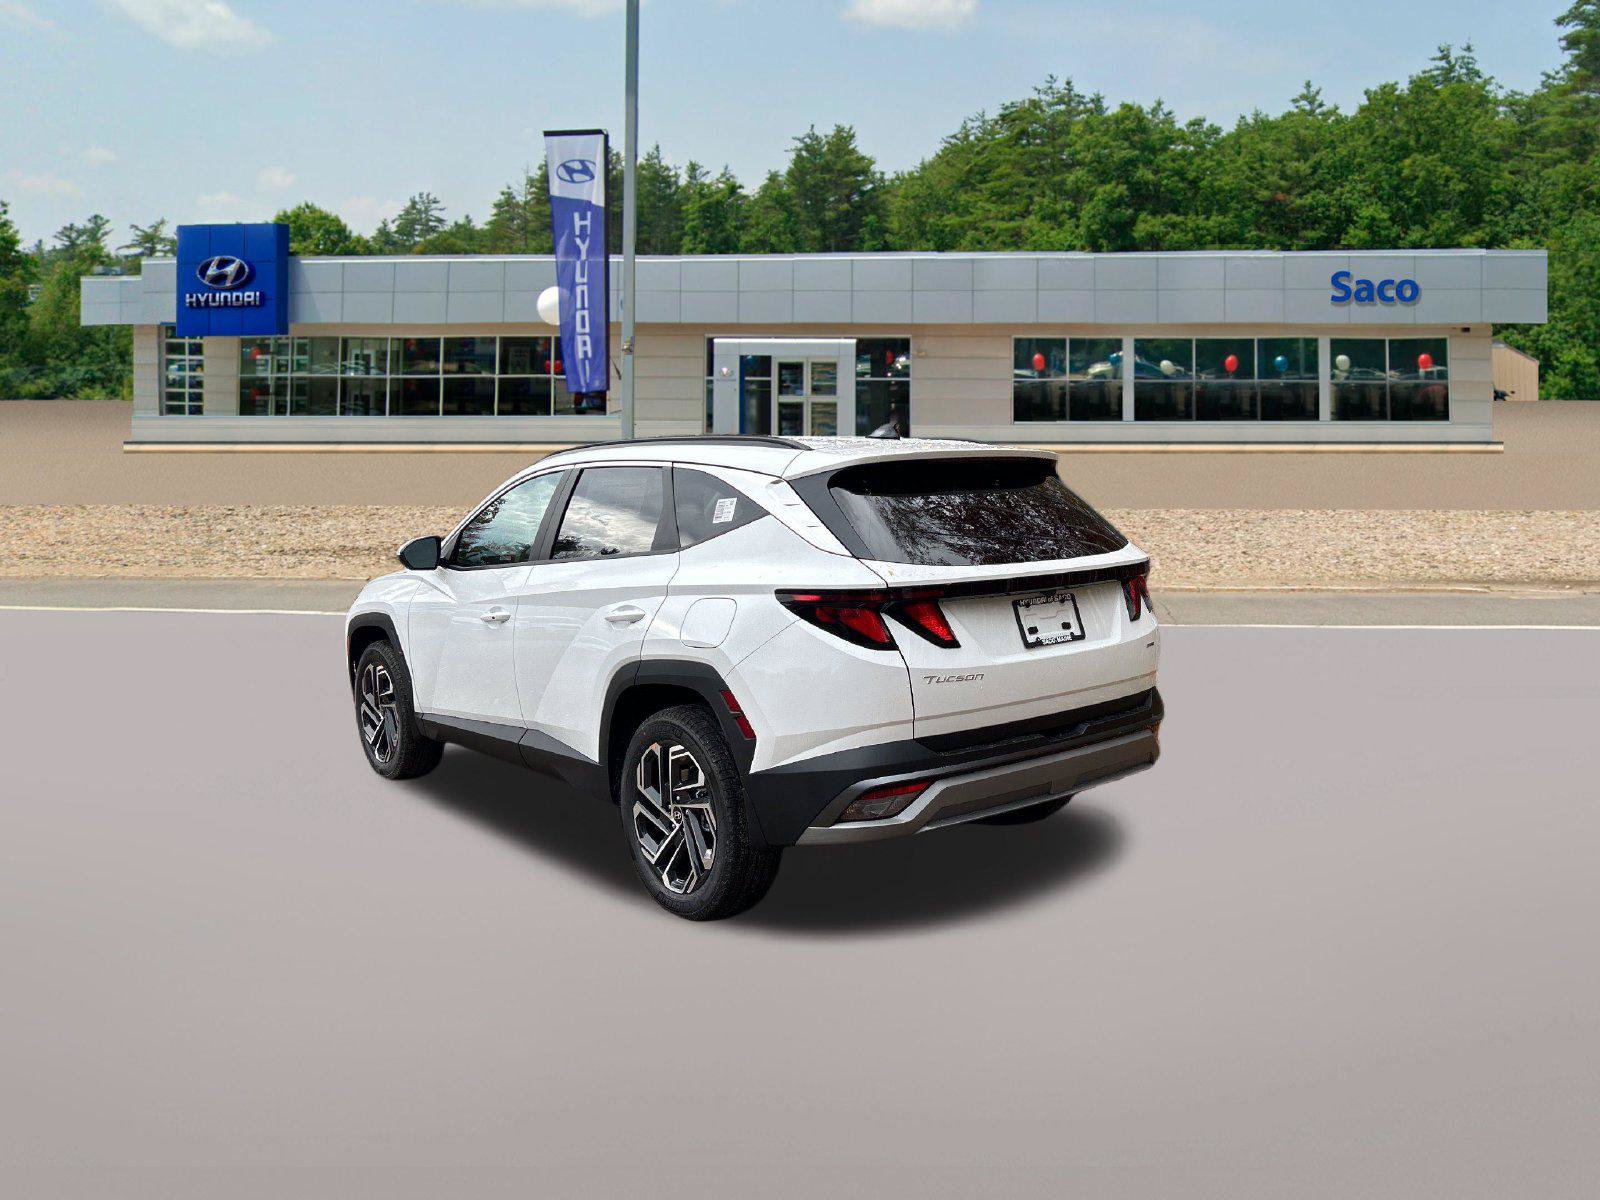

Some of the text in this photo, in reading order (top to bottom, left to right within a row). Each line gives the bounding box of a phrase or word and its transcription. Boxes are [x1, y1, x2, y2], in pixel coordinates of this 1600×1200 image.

[185, 291, 260, 307] HYUNDAI
[573, 211, 592, 383] HYUNDAI
[1330, 270, 1420, 303] Saco
